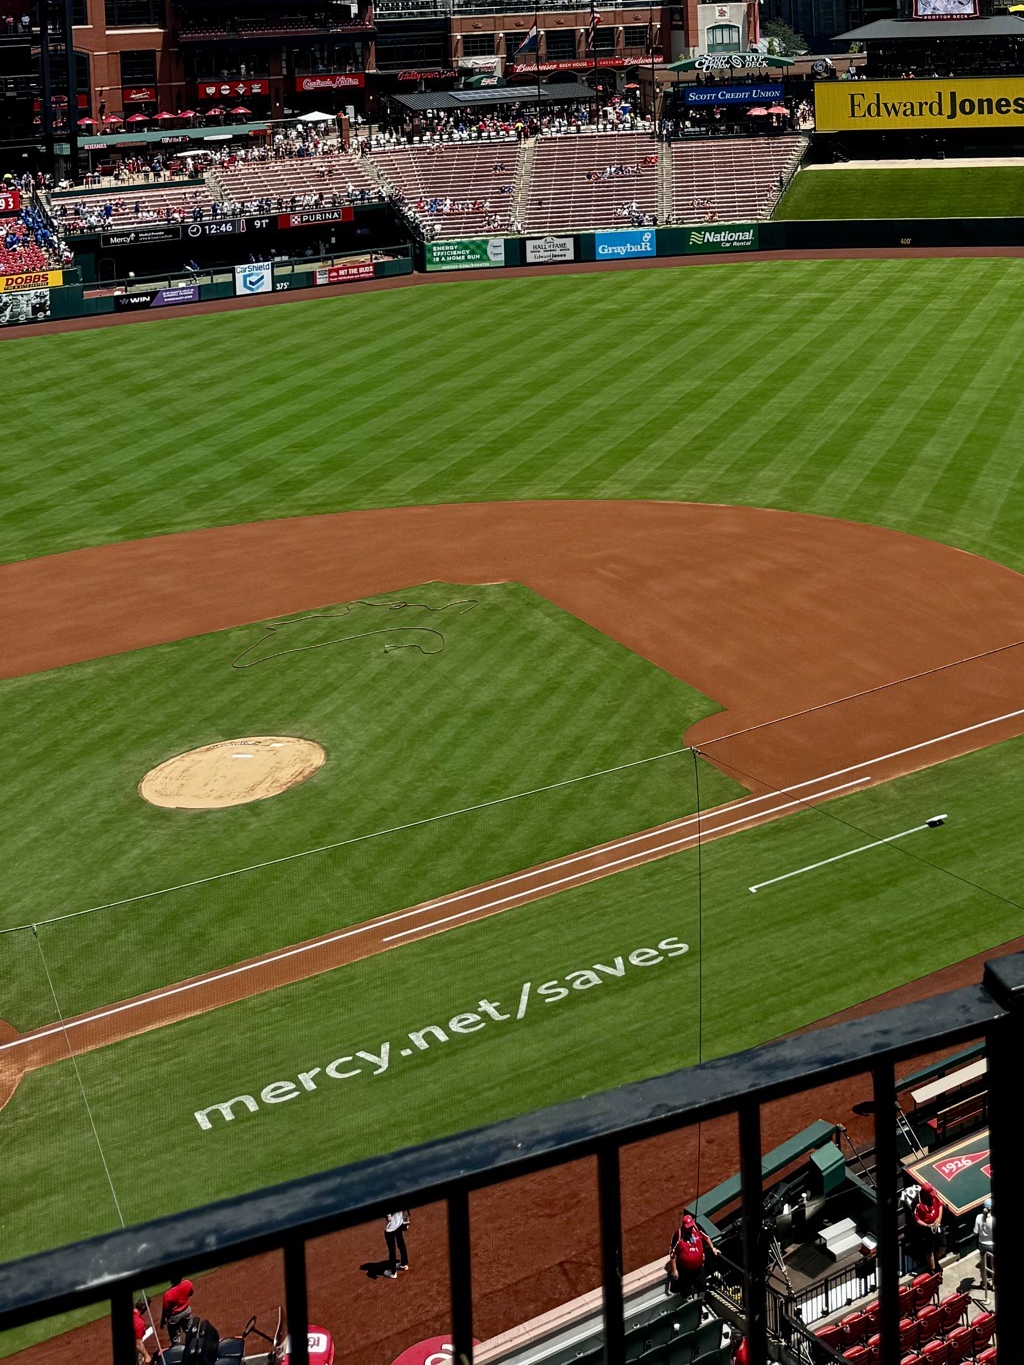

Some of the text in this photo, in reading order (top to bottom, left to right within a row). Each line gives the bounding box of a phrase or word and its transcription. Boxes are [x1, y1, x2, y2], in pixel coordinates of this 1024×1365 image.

[688, 89, 781, 101] SCOTT CREDIT UNION
[848, 91, 943, 118] Edward
[302, 212, 340, 223] PURINA
[204, 219, 270, 234] 12:46 91°
[110, 235, 131, 244] Mercy
[703, 229, 753, 243] National
[433, 249, 470, 257] EFFICIENCY
[598, 243, 653, 255] GraybaR
[236, 263, 270, 274] CarShield
[5, 273, 49, 286] DOBBS
[130, 296, 150, 304] WIN
[193, 936, 691, 1131] mercy.net/saves
[941, 1156, 972, 1174] 1926
